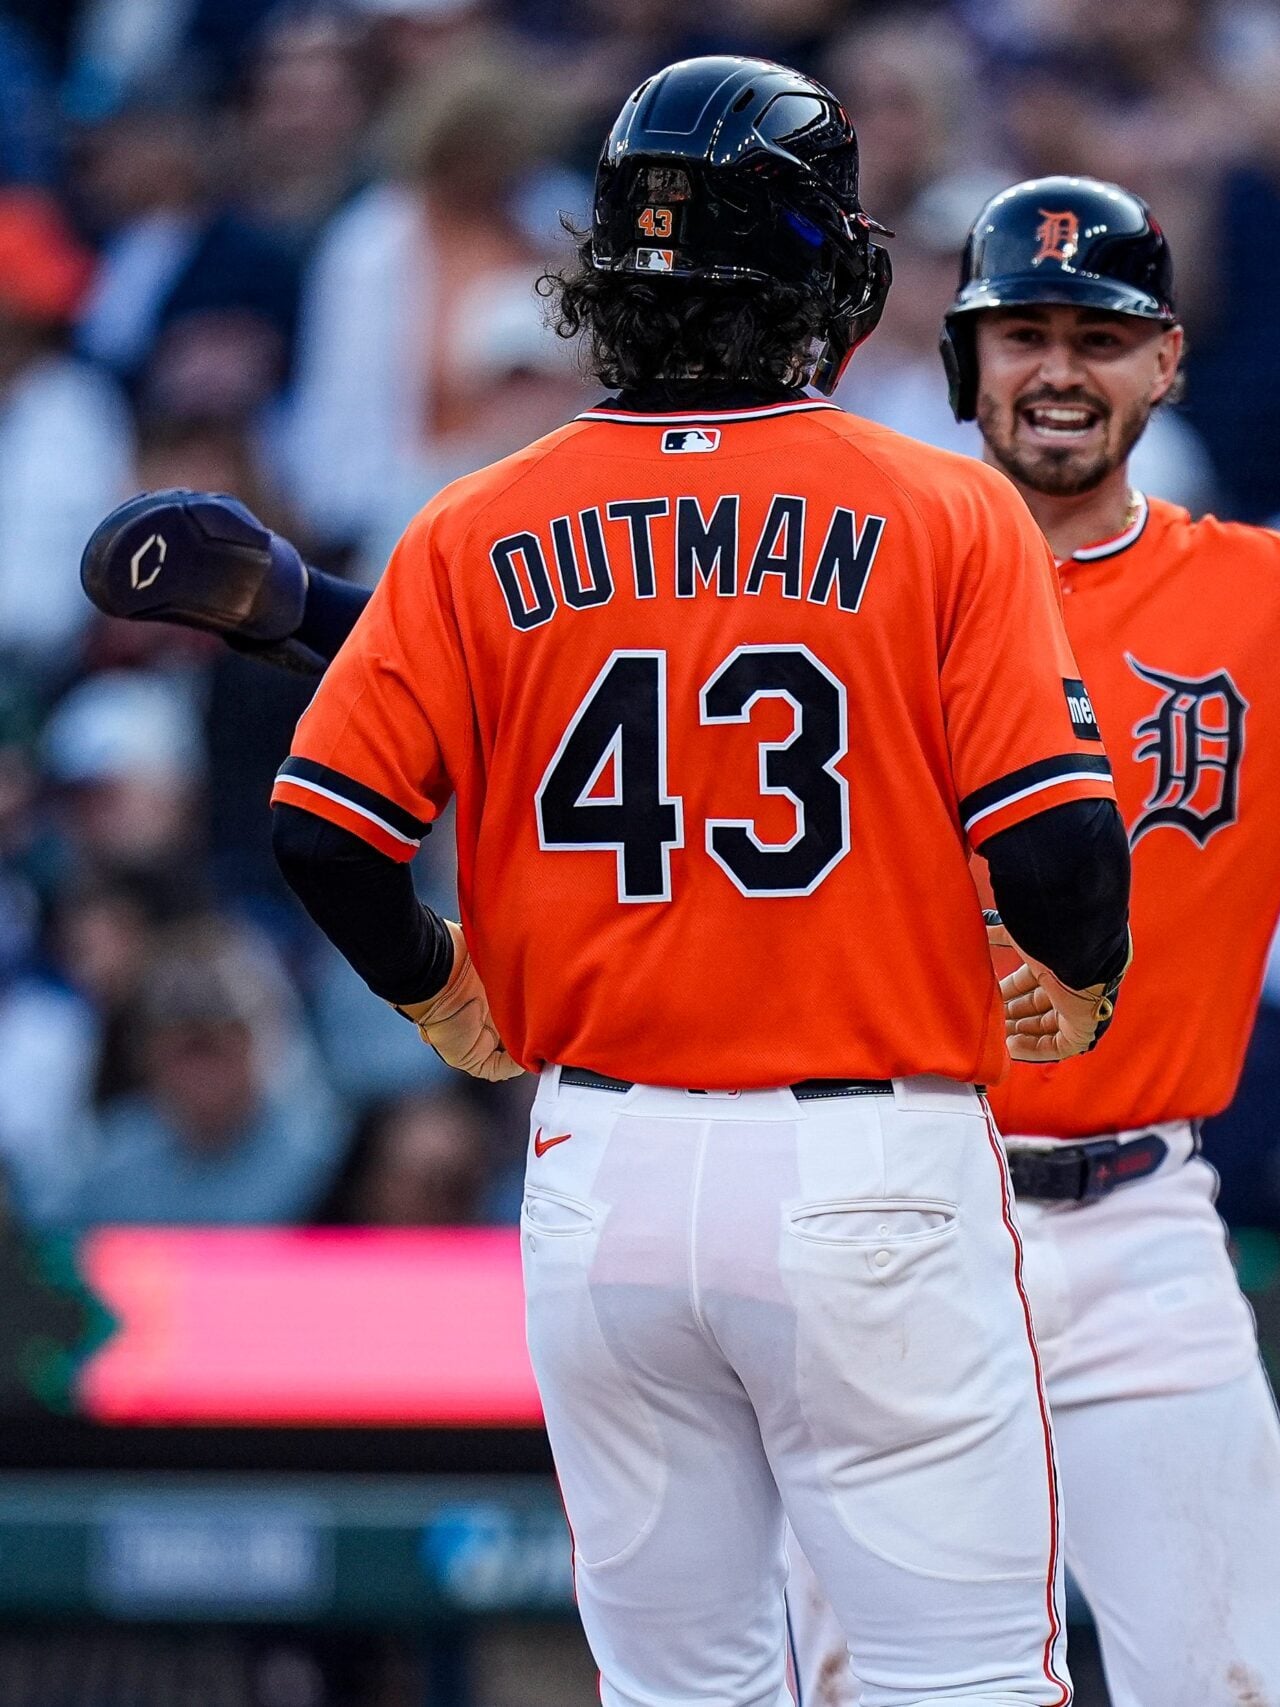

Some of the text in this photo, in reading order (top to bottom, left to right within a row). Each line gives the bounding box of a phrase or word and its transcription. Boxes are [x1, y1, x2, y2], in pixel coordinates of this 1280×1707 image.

[638, 208, 672, 237] 43
[489, 494, 887, 632] OUTMAN
[534, 643, 852, 903] 43
[1123, 651, 1250, 852] D
